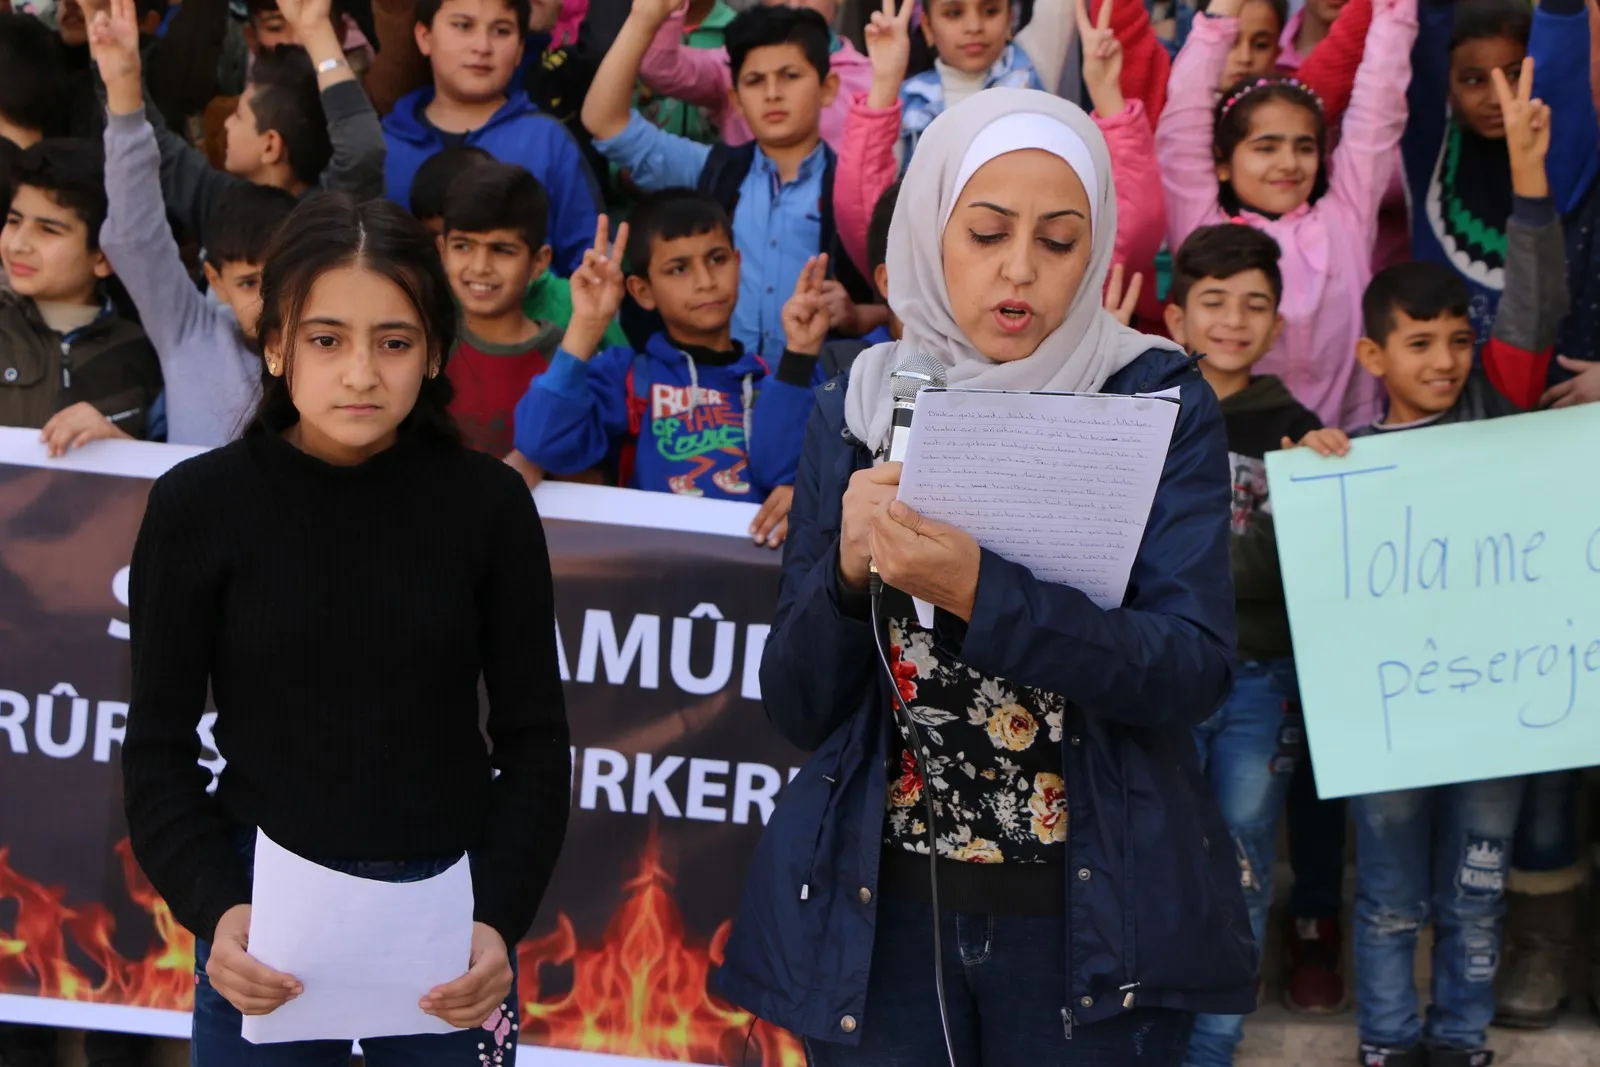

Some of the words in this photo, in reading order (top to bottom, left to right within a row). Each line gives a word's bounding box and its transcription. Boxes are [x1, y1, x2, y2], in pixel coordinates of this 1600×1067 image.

[1290, 465, 1447, 600] Tola
[1475, 530, 1546, 588] me
[569, 746, 801, 826] RKER
